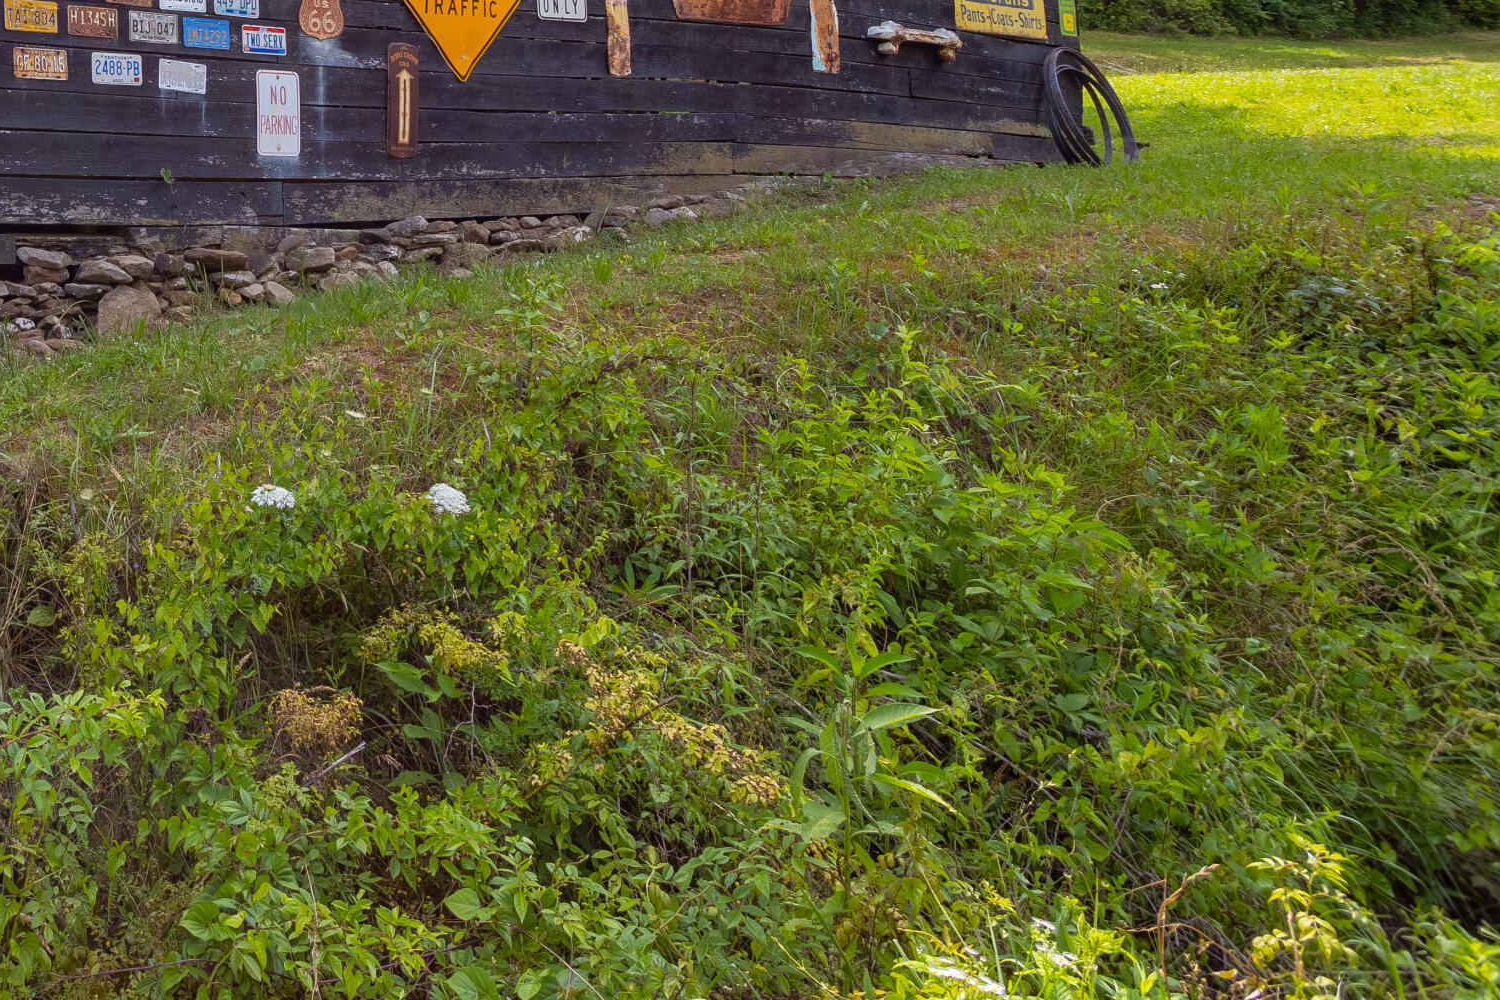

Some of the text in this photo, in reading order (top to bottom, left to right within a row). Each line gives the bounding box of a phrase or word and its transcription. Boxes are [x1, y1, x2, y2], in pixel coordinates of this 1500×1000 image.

[34, 10, 56, 27] 834
[70, 9, 116, 28] H1345H
[308, 10, 336, 34] 66
[132, 20, 175, 37] BIJ 047
[245, 32, 283, 49] TWO SERV
[95, 60, 140, 77] 2488-PB
[269, 85, 287, 106] NO
[260, 114, 298, 136] PARKING
